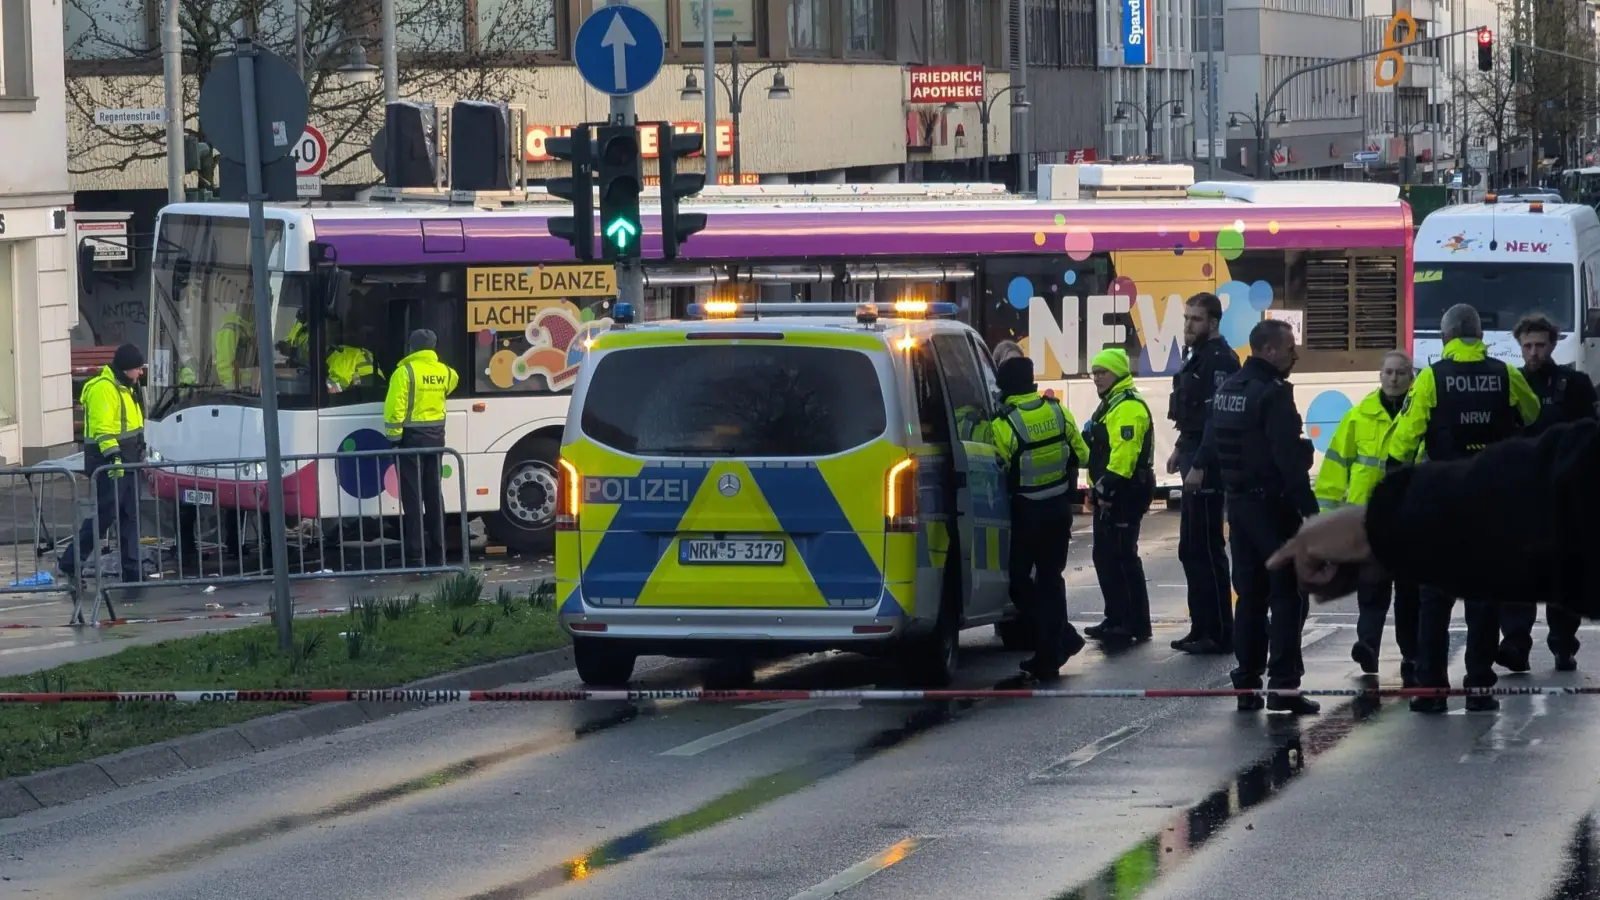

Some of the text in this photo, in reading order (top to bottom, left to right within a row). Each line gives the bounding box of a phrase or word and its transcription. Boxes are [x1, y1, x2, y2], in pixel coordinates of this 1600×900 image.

[911, 71, 982, 83] FRIEDRICH
[913, 86, 982, 98] APOTHEKE
[99, 111, 160, 123] Regentenstraße
[1506, 241, 1548, 252] NEW
[474, 273, 534, 294] FIERE,
[540, 271, 611, 292] DANZE,
[474, 306, 538, 325] LACHE
[1029, 295, 1187, 375] NEW
[422, 375, 445, 385] NEW
[1445, 375, 1502, 393] POLIZEI
[1213, 393, 1248, 413] POLIZEI
[1460, 410, 1491, 425] NRW
[1027, 418, 1061, 437] POLIZEI
[585, 479, 689, 501] POLIZEI
[689, 543, 718, 559] NRW
[727, 542, 784, 559] 5-3179
[346, 690, 461, 702] FEUERWEHR
